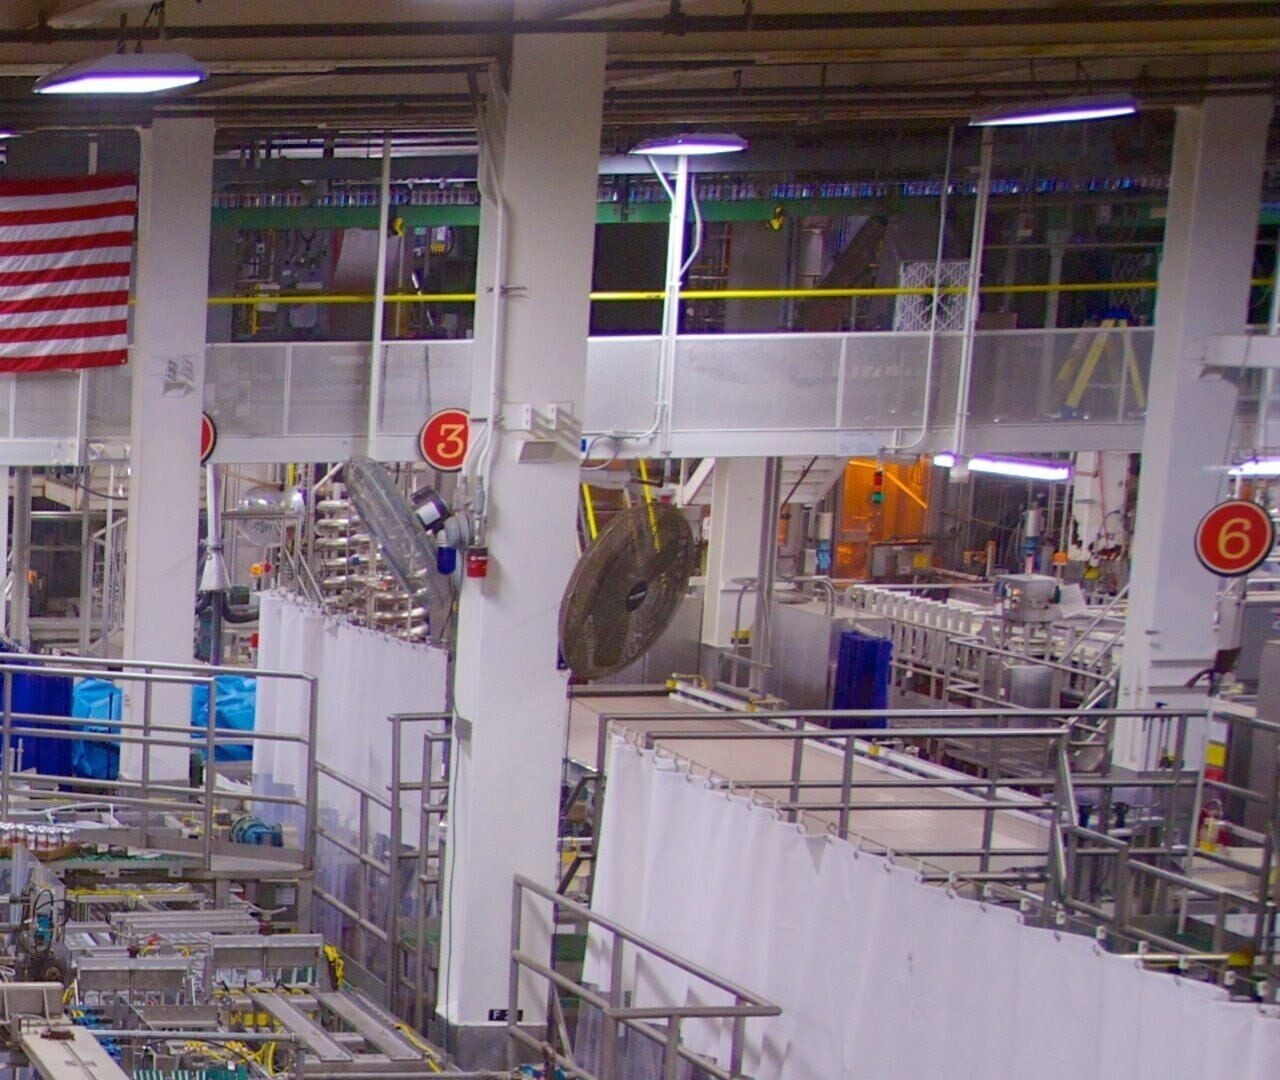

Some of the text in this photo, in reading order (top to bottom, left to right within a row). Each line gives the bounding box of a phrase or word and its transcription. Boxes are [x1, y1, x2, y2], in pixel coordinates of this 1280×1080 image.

[437, 424, 466, 459] 3
[1218, 518, 1252, 560] 6
[493, 1010, 501, 1020] F
